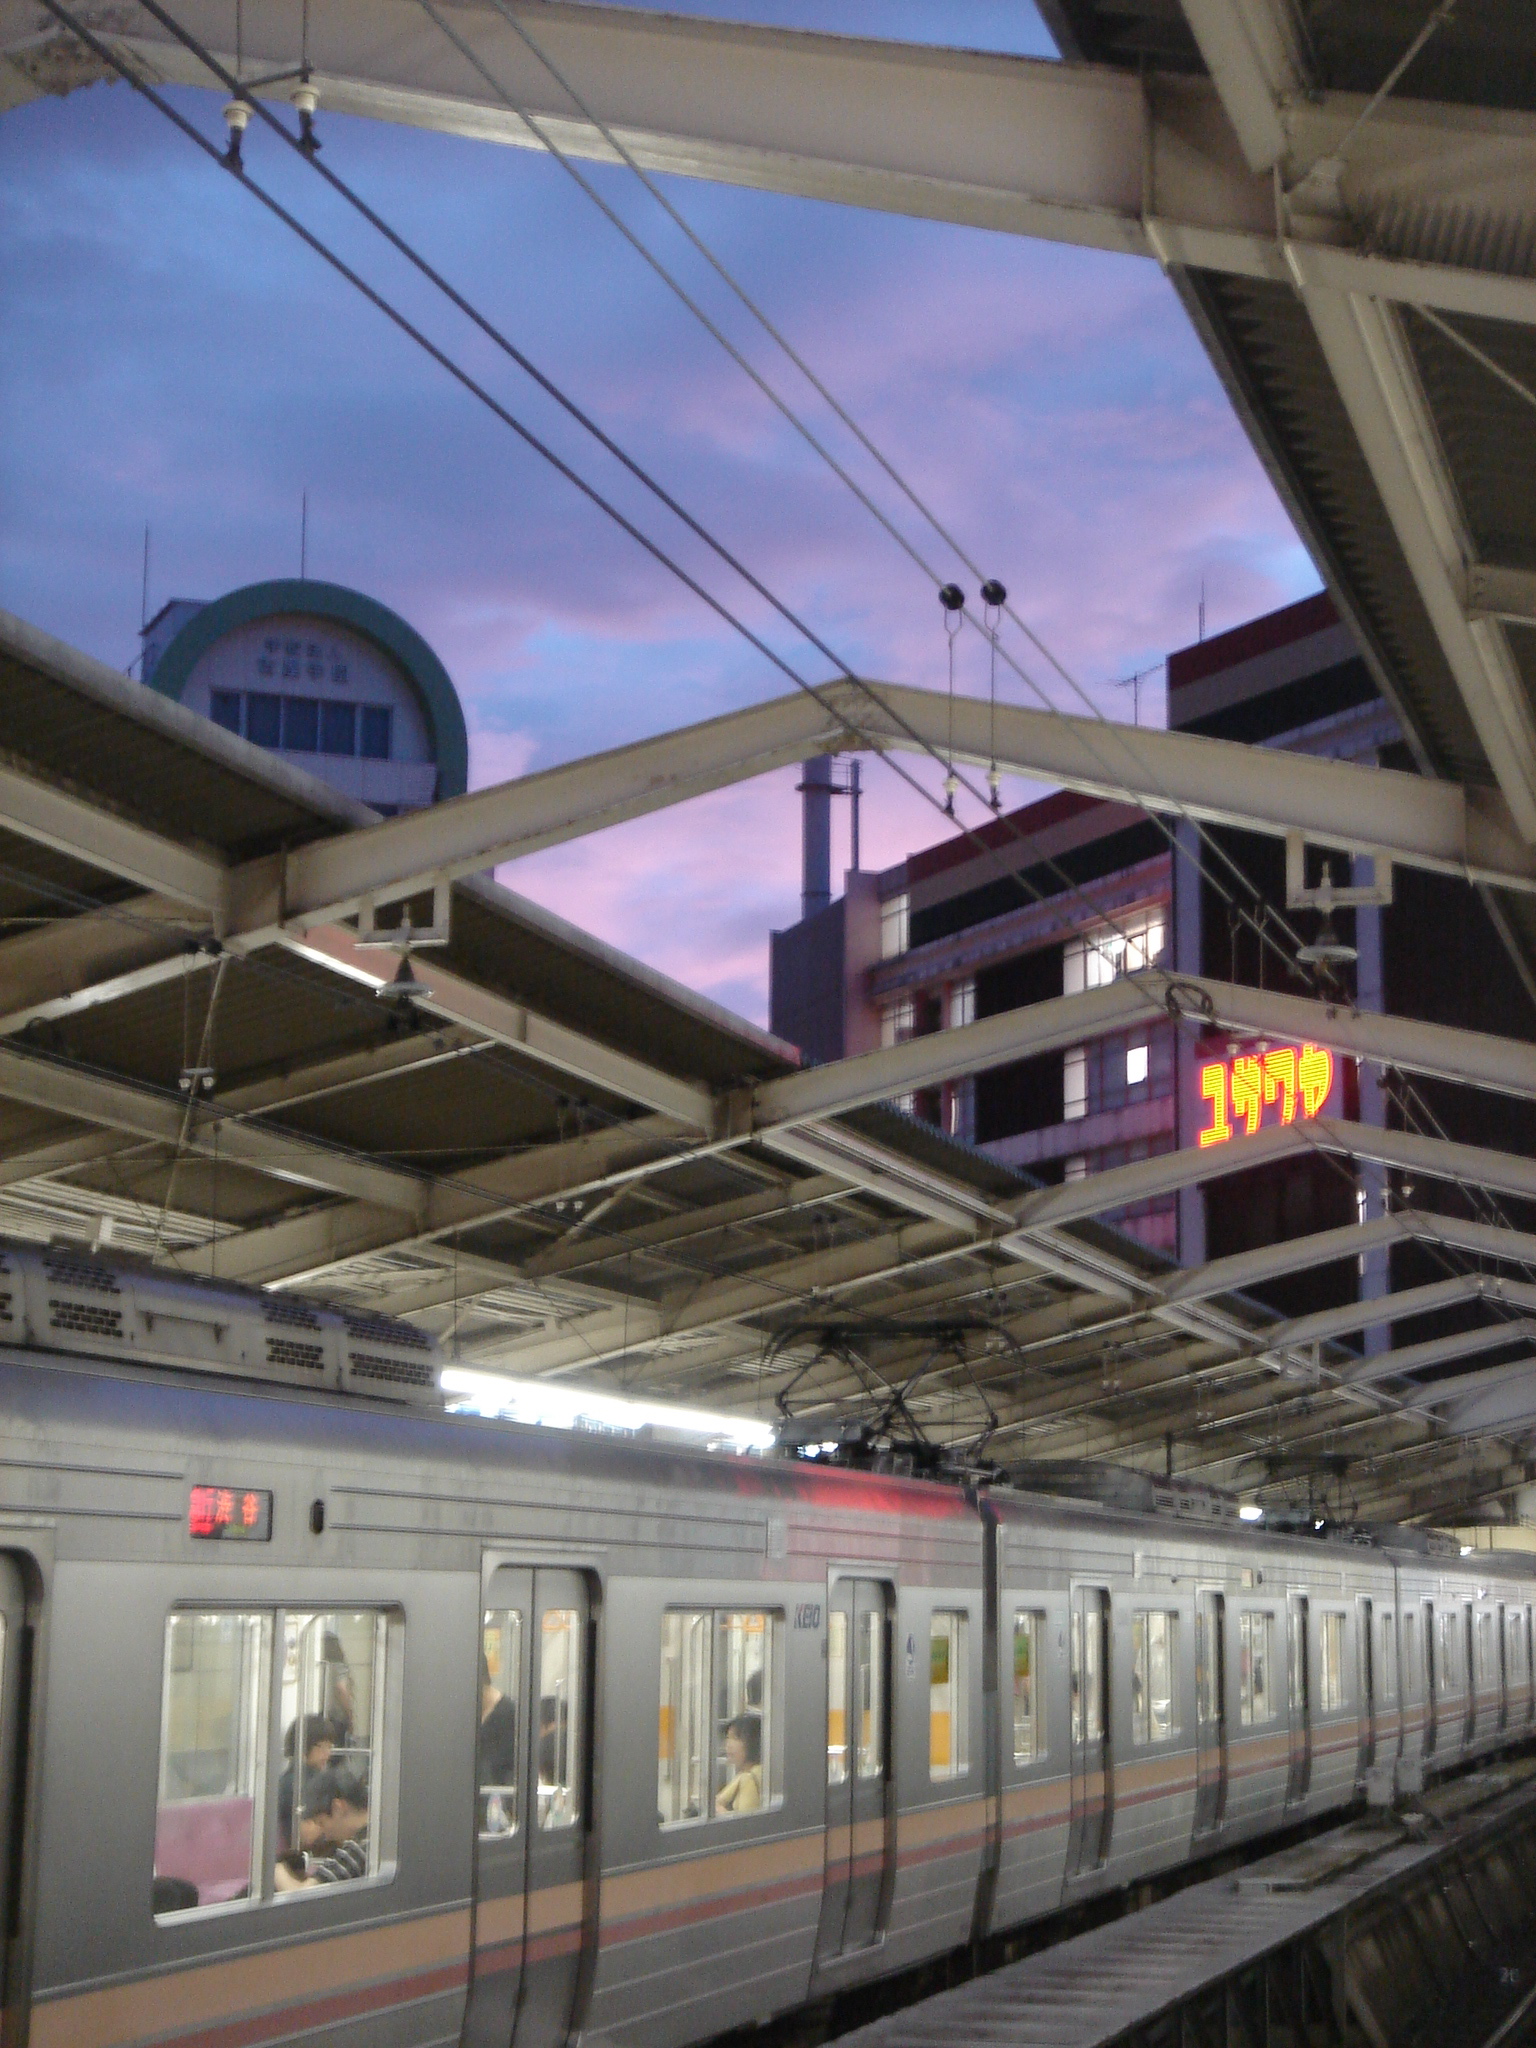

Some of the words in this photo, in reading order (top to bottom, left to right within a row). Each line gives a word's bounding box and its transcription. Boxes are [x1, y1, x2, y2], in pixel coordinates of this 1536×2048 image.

[1199, 1042, 1334, 1148] ユザワヤ
[794, 1603, 821, 1629] KEIO
